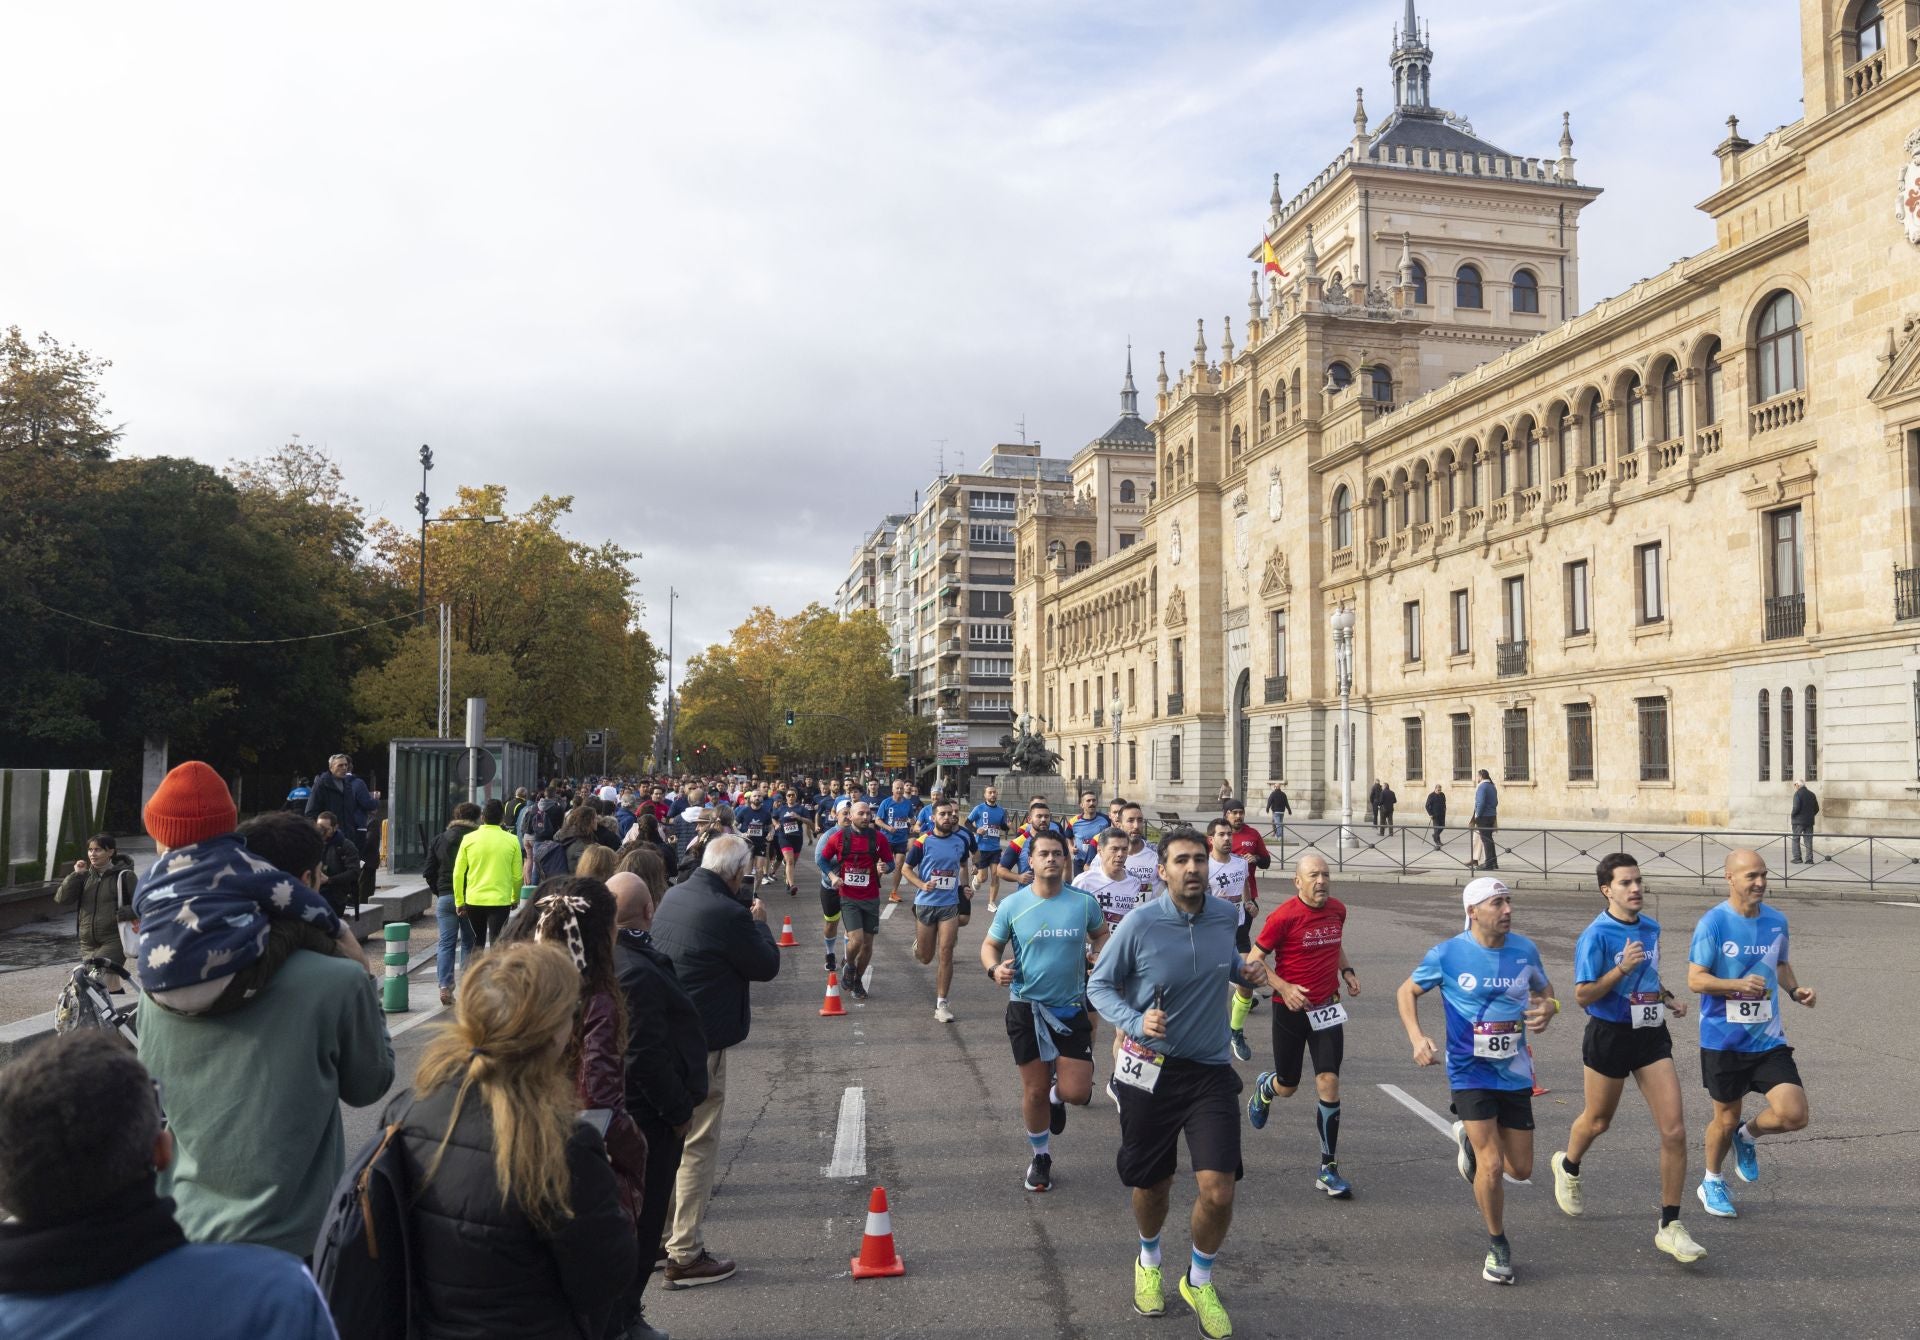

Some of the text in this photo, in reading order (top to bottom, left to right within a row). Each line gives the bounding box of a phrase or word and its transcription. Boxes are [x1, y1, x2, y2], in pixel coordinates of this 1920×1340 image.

[588, 734, 600, 744] P
[848, 874, 866, 882] 329
[938, 878, 949, 886] 11
[1033, 928, 1080, 938] ADIENT
[1312, 1006, 1340, 1024] 122
[1643, 1006, 1658, 1020] 85
[1740, 1002, 1760, 1016] 87
[1488, 1036, 1510, 1052] 86
[1122, 1056, 1143, 1080] 34
